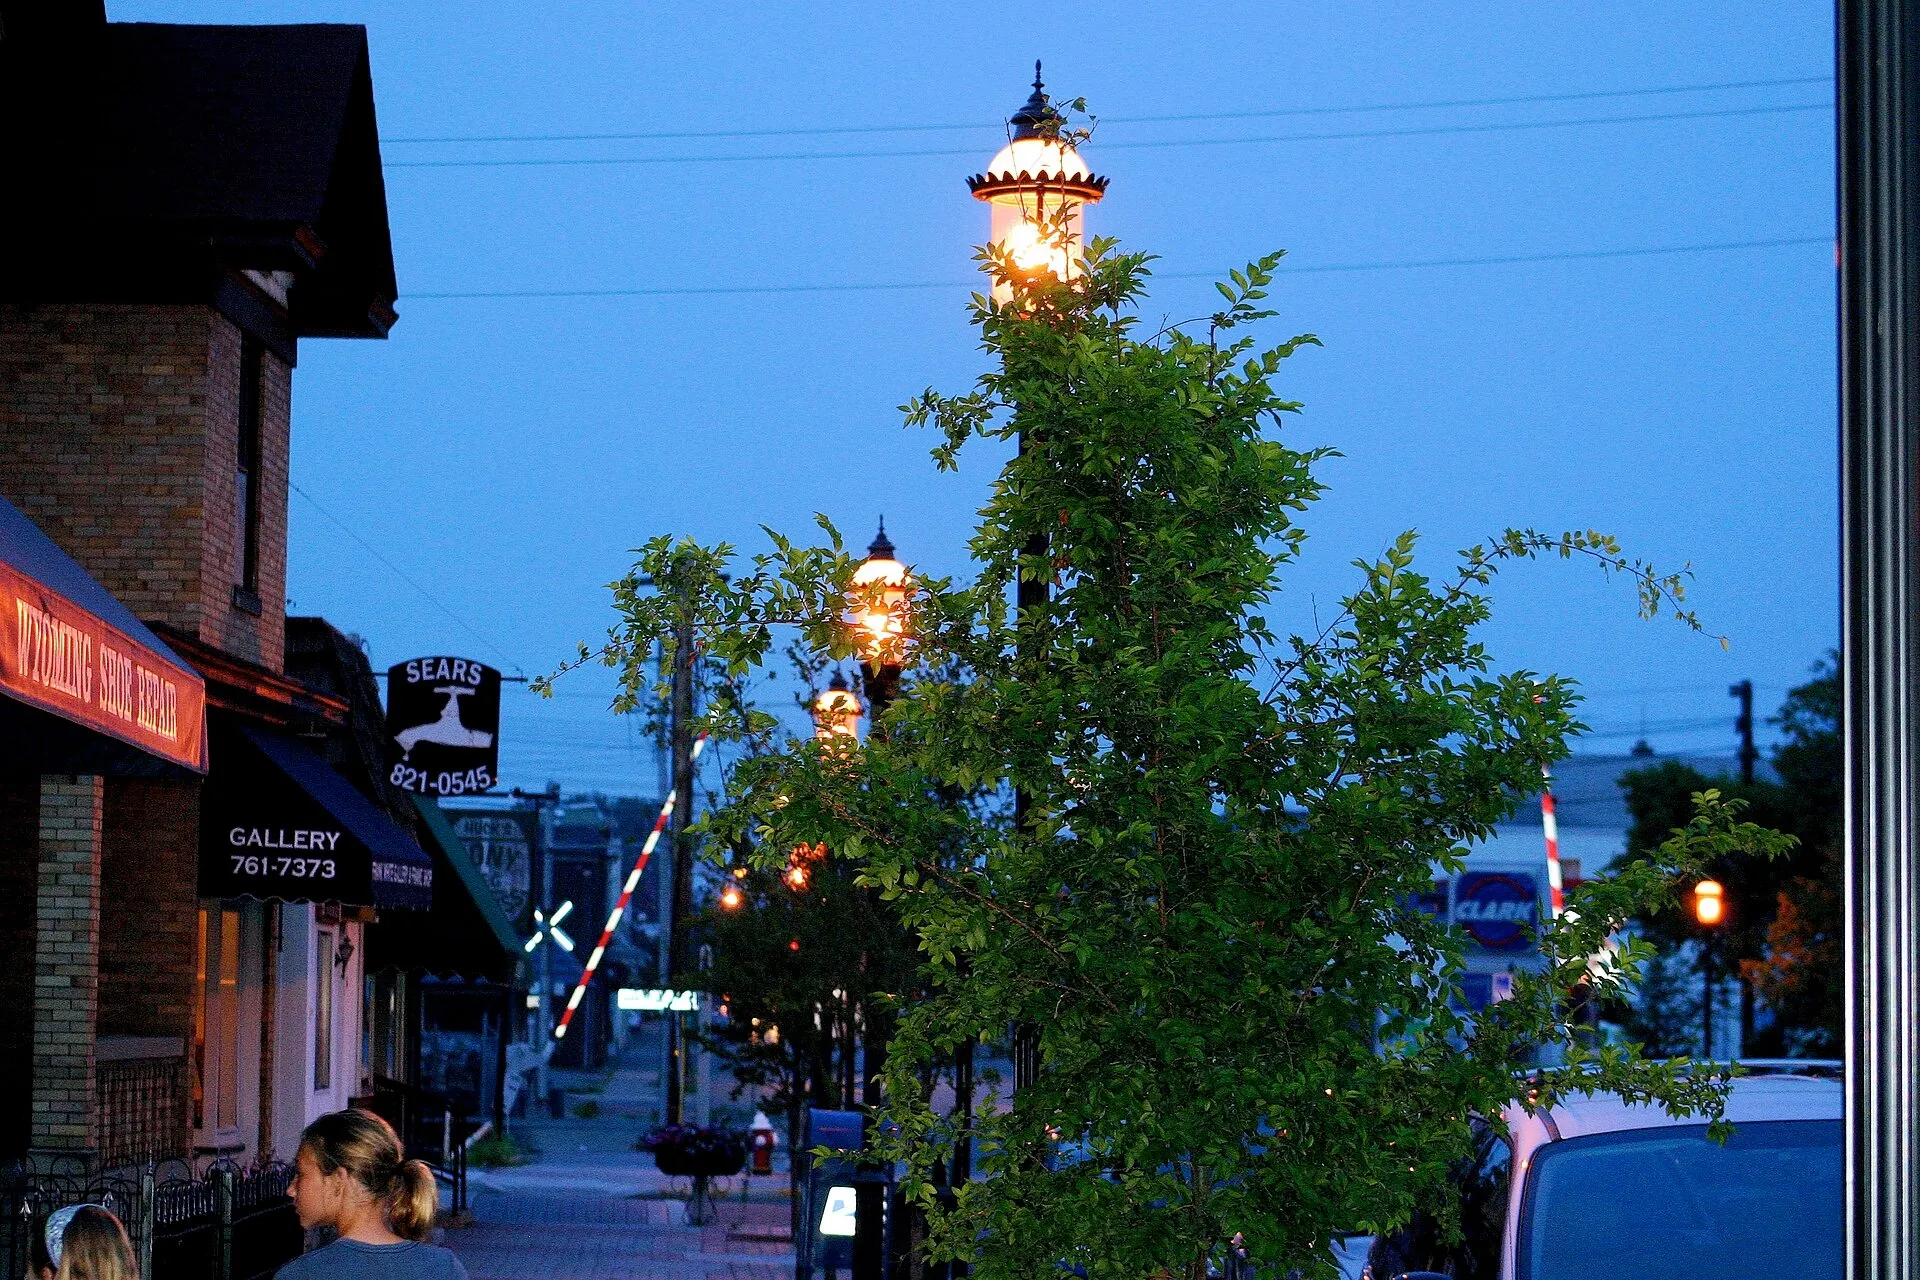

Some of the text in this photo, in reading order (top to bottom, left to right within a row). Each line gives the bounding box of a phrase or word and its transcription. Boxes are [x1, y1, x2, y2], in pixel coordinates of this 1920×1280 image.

[16, 597, 177, 742] WYOMING SHOE REPAIR
[406, 658, 482, 685] SEARS
[390, 764, 491, 795] 821-0545
[229, 827, 340, 850] GALLERY
[230, 856, 336, 878] 761-7373
[1454, 900, 1533, 921] CLARK
